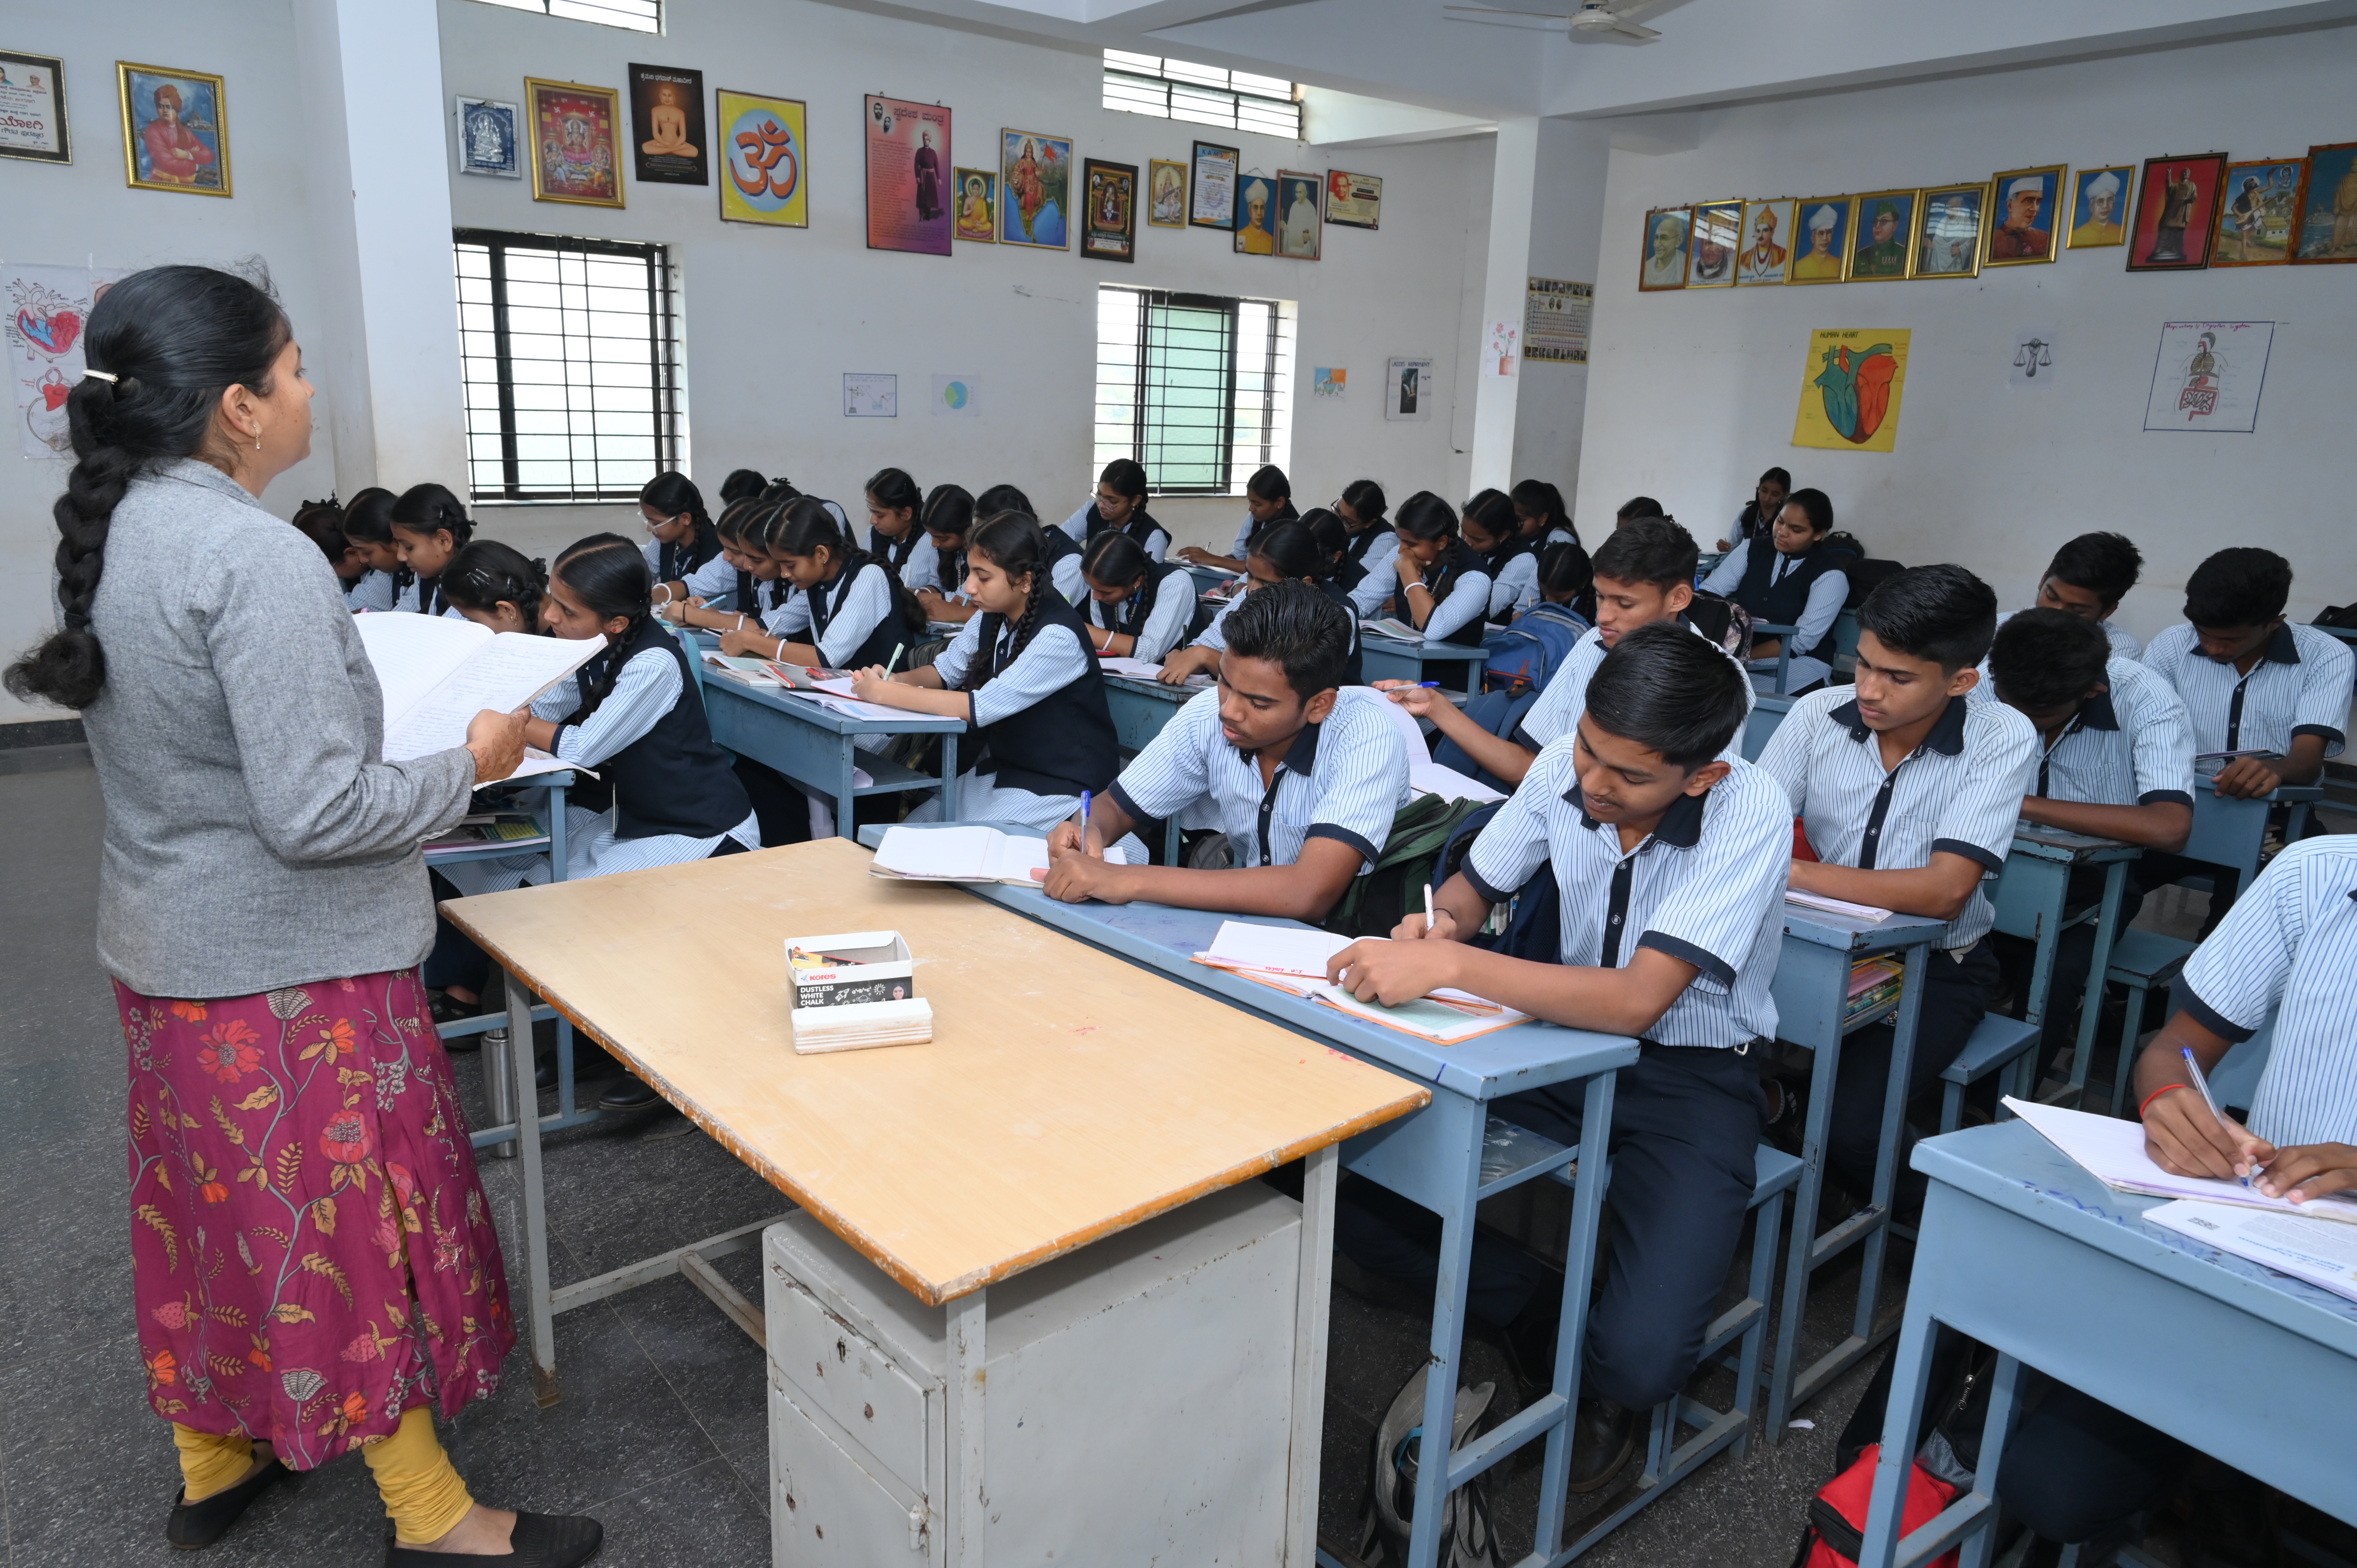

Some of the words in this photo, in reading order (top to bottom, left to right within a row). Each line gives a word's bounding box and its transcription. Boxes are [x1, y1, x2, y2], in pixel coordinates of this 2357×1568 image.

[894, 107, 917, 121] ಸ್ವದೇಶ
[922, 111, 944, 126] ಮಂತ್ರ
[21, 131, 44, 139] ಪುರಸ್ಕಾರ
